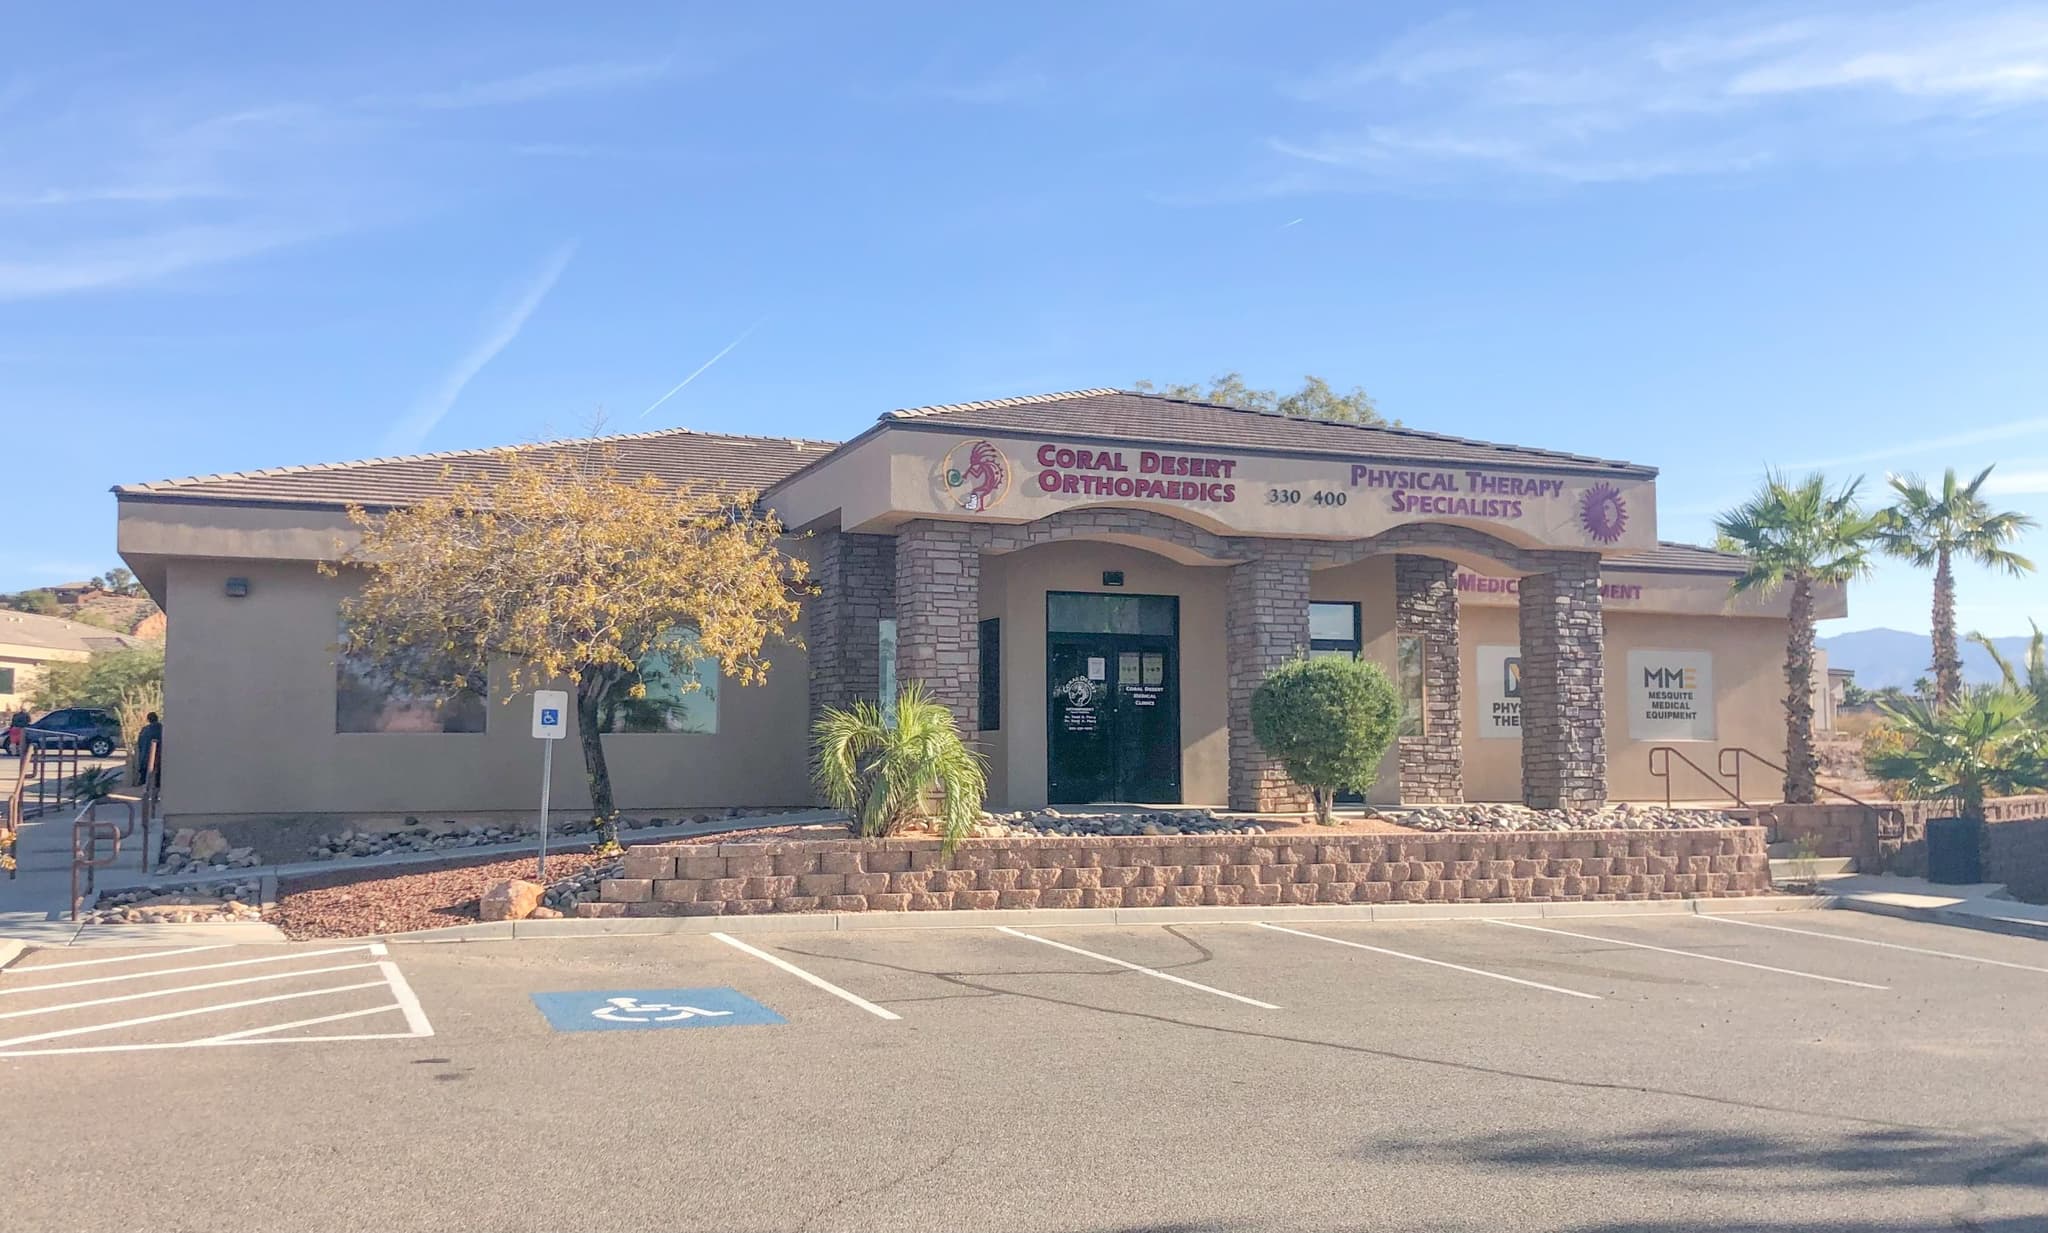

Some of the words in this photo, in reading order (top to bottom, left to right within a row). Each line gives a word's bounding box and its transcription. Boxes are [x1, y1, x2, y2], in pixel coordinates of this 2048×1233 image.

[1037, 444, 1128, 472] CORAL
[1140, 451, 1236, 479] DESERT
[1038, 469, 1236, 503] ORTHOPAEDICS
[1351, 464, 1458, 492] PHYSICAL
[1465, 471, 1564, 498] THERAPY
[1269, 488, 1301, 504] 330
[1313, 490, 1347, 506] 400
[1391, 490, 1522, 518] SPECIALISTS
[1458, 573, 1519, 594] MEDIC
[1644, 666, 1697, 689] MME
[1648, 691, 1694, 701] MESQUITE
[1652, 701, 1691, 710] MEDICAL
[1646, 711, 1697, 720] EQUIPMENT
